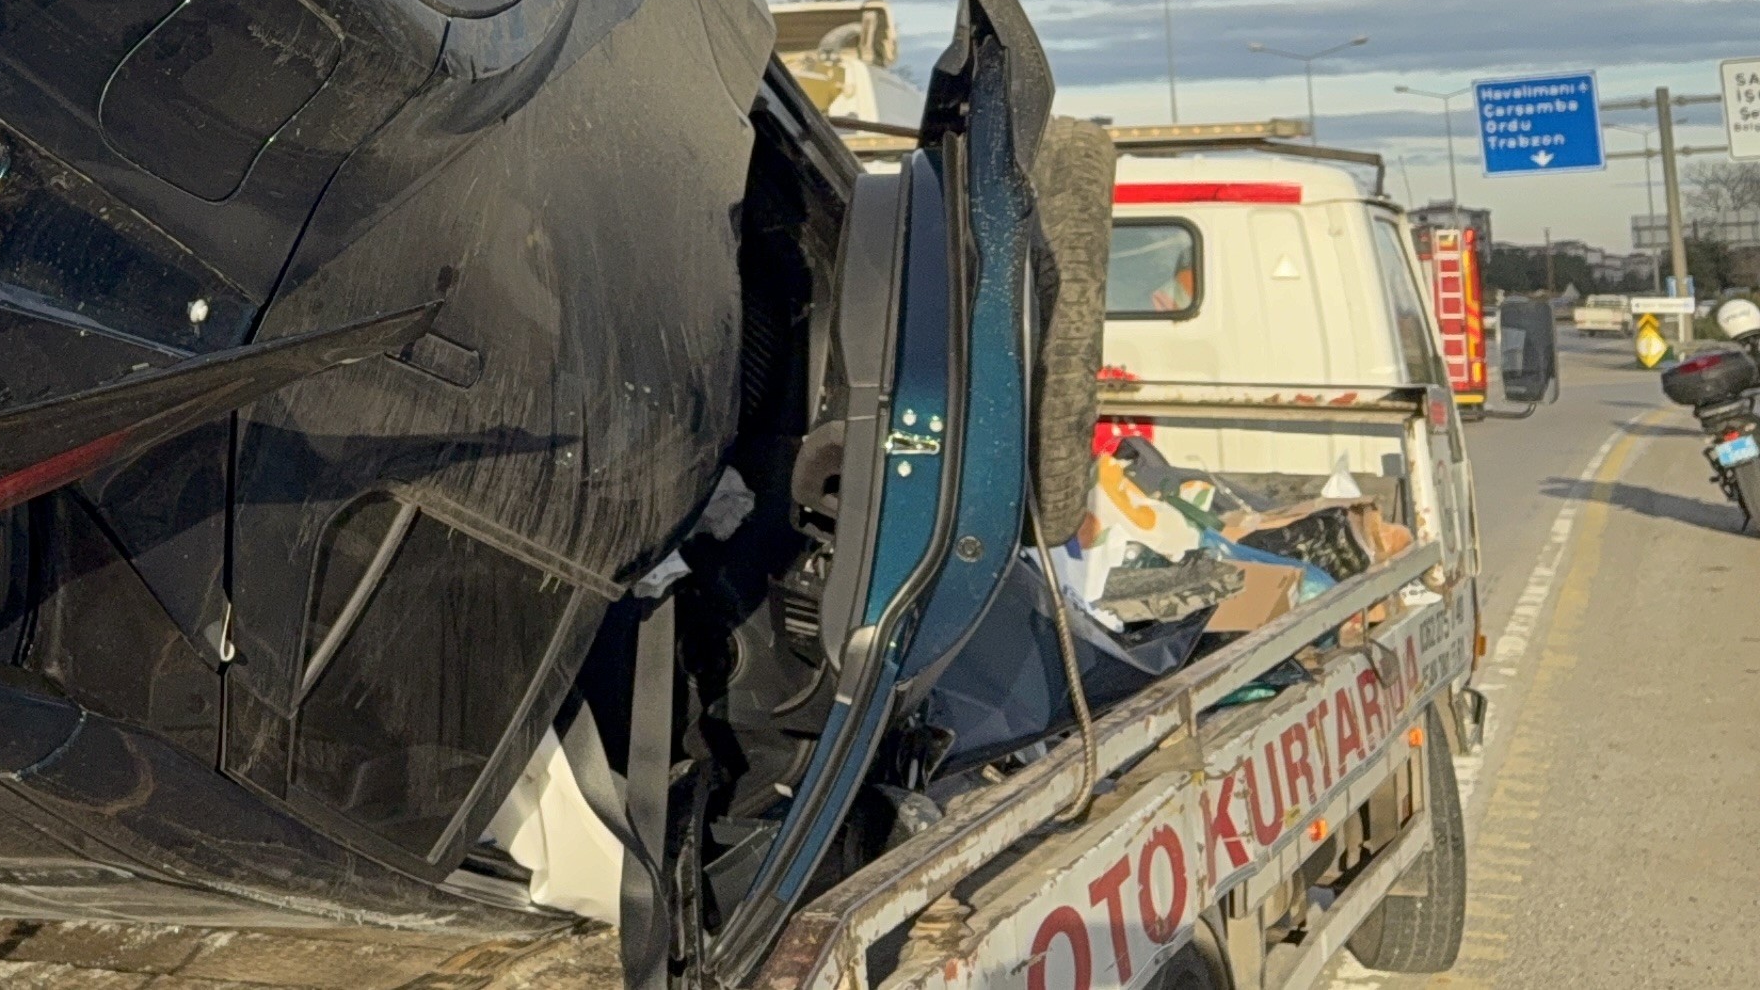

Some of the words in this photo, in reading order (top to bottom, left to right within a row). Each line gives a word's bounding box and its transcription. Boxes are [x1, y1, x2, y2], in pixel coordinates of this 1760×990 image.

[1483, 99, 1578, 118] Çarşamba
[1485, 118, 1532, 134] Ordu
[1487, 133, 1565, 150] Trabzon
[1028, 824, 1187, 990] OTO
